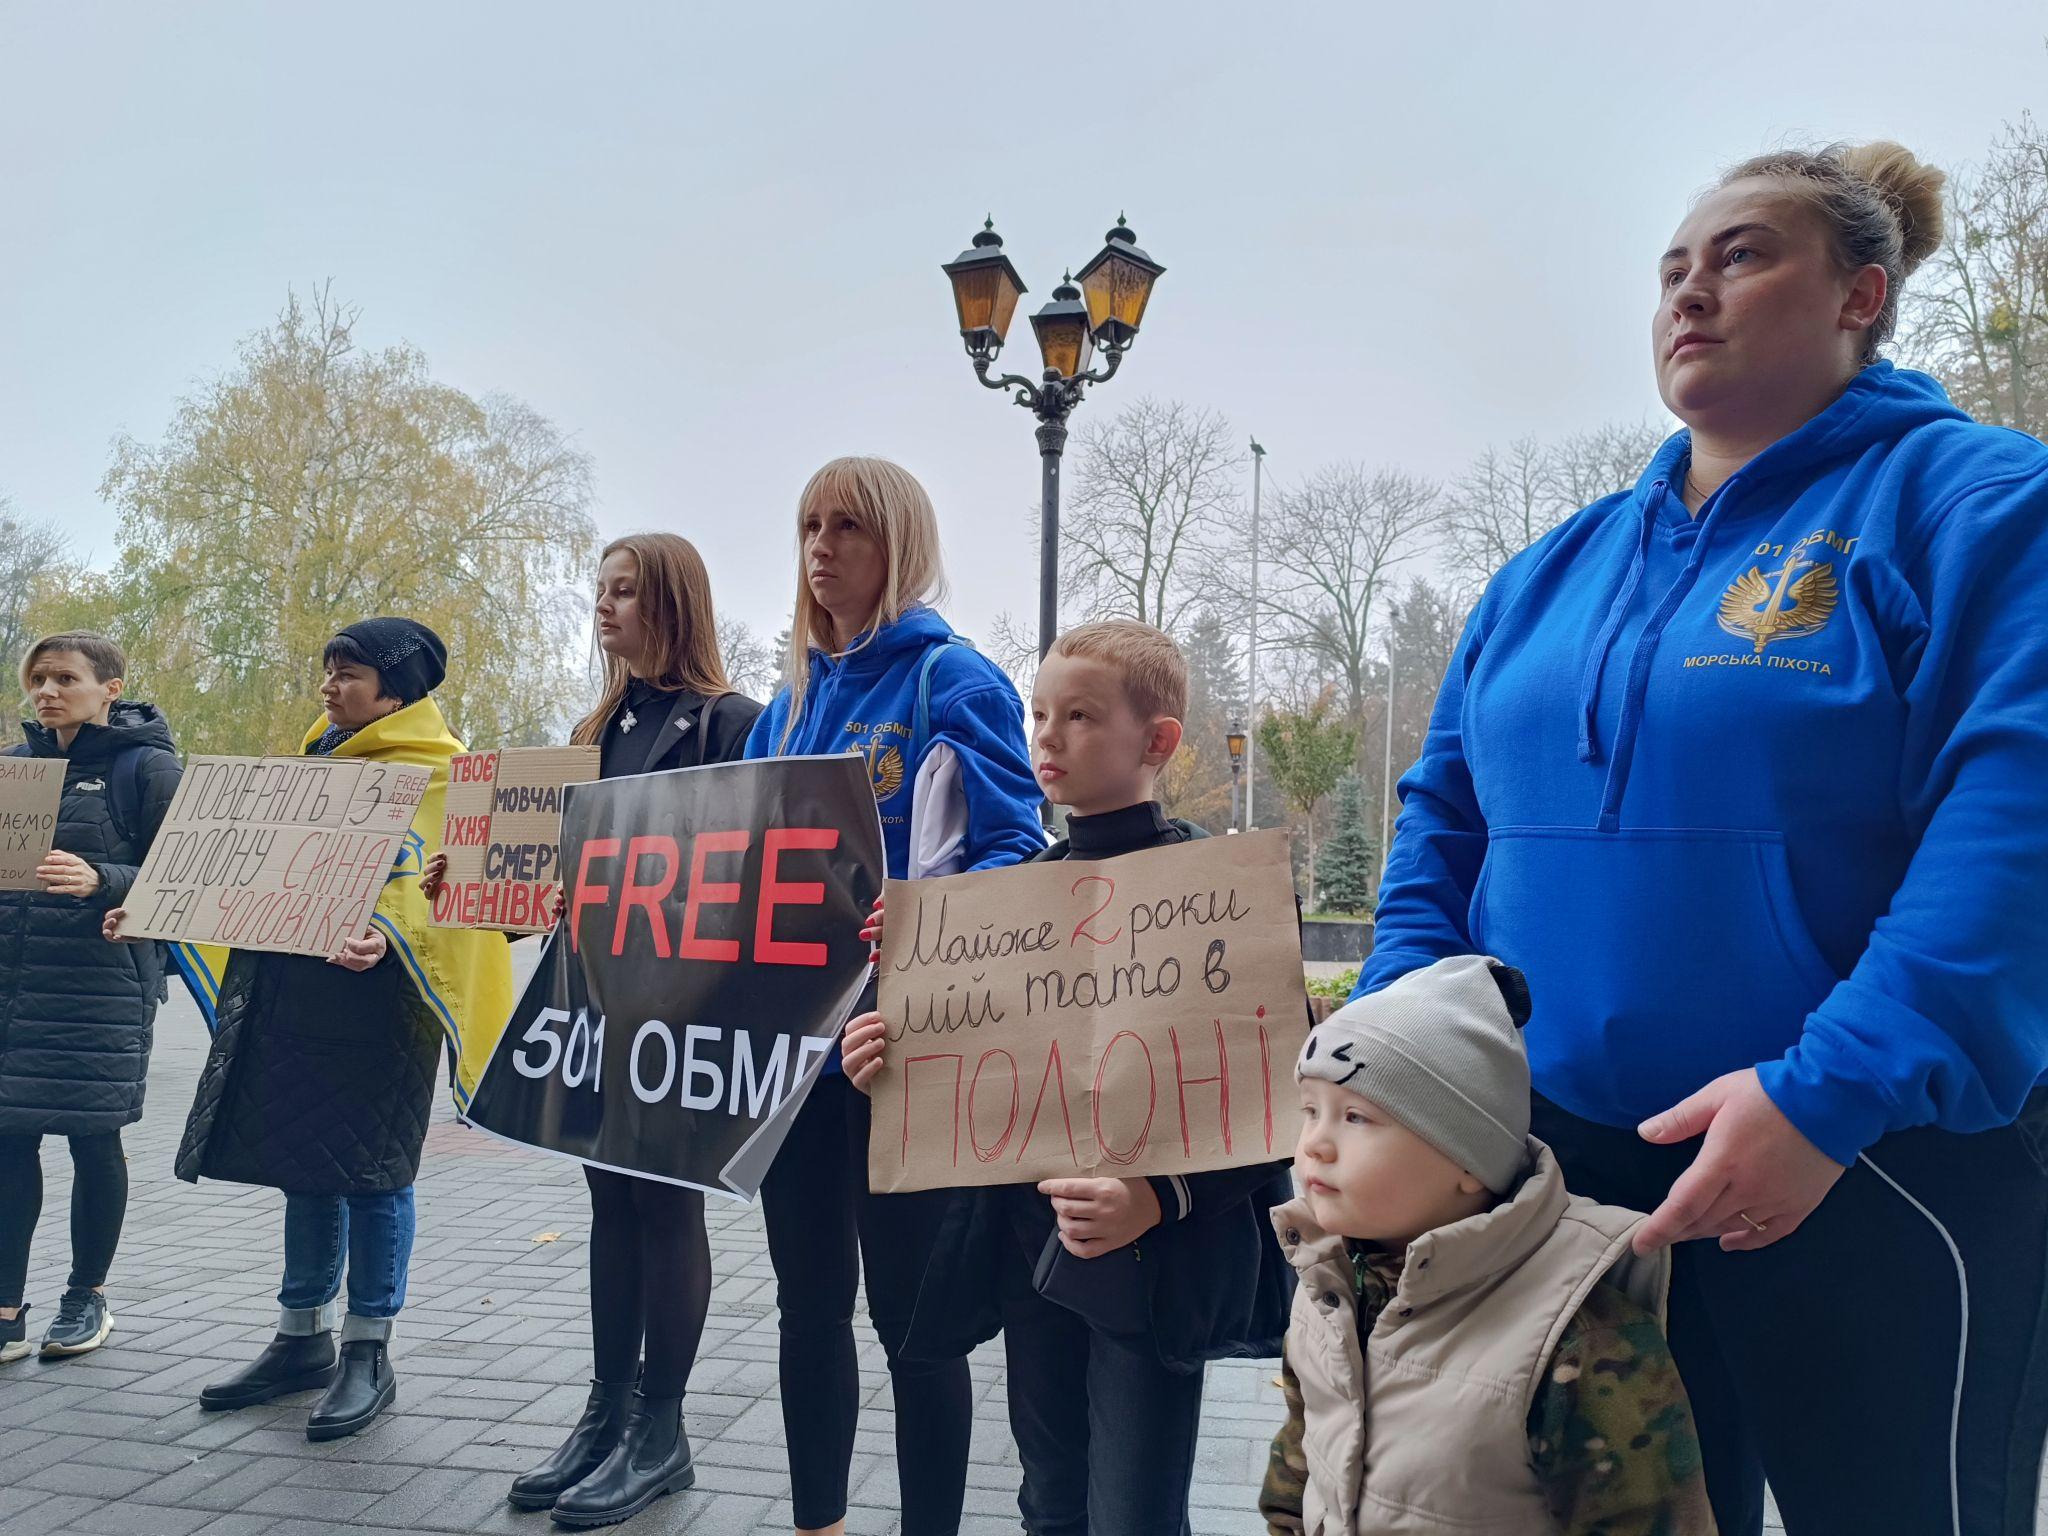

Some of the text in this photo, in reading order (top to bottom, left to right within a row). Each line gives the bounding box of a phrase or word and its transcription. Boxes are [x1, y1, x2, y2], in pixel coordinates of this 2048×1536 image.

[1754, 541, 1784, 558] 01
[1682, 654, 1832, 675] МОРСЬКА ПІХОТА
[845, 721, 913, 739] 501 ОБМП
[394, 774, 428, 792] FREE
[451, 753, 497, 783] ТВОЄ
[173, 763, 332, 823] ПОВЕРНІТЬ
[388, 791, 419, 806] AZOV
[0, 812, 53, 831] АЄМО
[387, 806, 405, 820] #
[880, 815, 904, 824] ХОТА
[444, 814, 491, 846] ЇХНЯ
[145, 828, 391, 898] ПОЛОНУ СИНА
[433, 879, 557, 931] ОЛЕНІВК
[570, 827, 839, 966] FREE
[144, 888, 366, 952] ТА ЧОЛОВІКА
[896, 876, 1251, 972] Майже 2 роки
[1025, 957, 1181, 1016] тато
[1200, 939, 1231, 994] в
[512, 1006, 606, 1093] 501
[902, 1004, 1274, 1168] ПОЛОНІ
